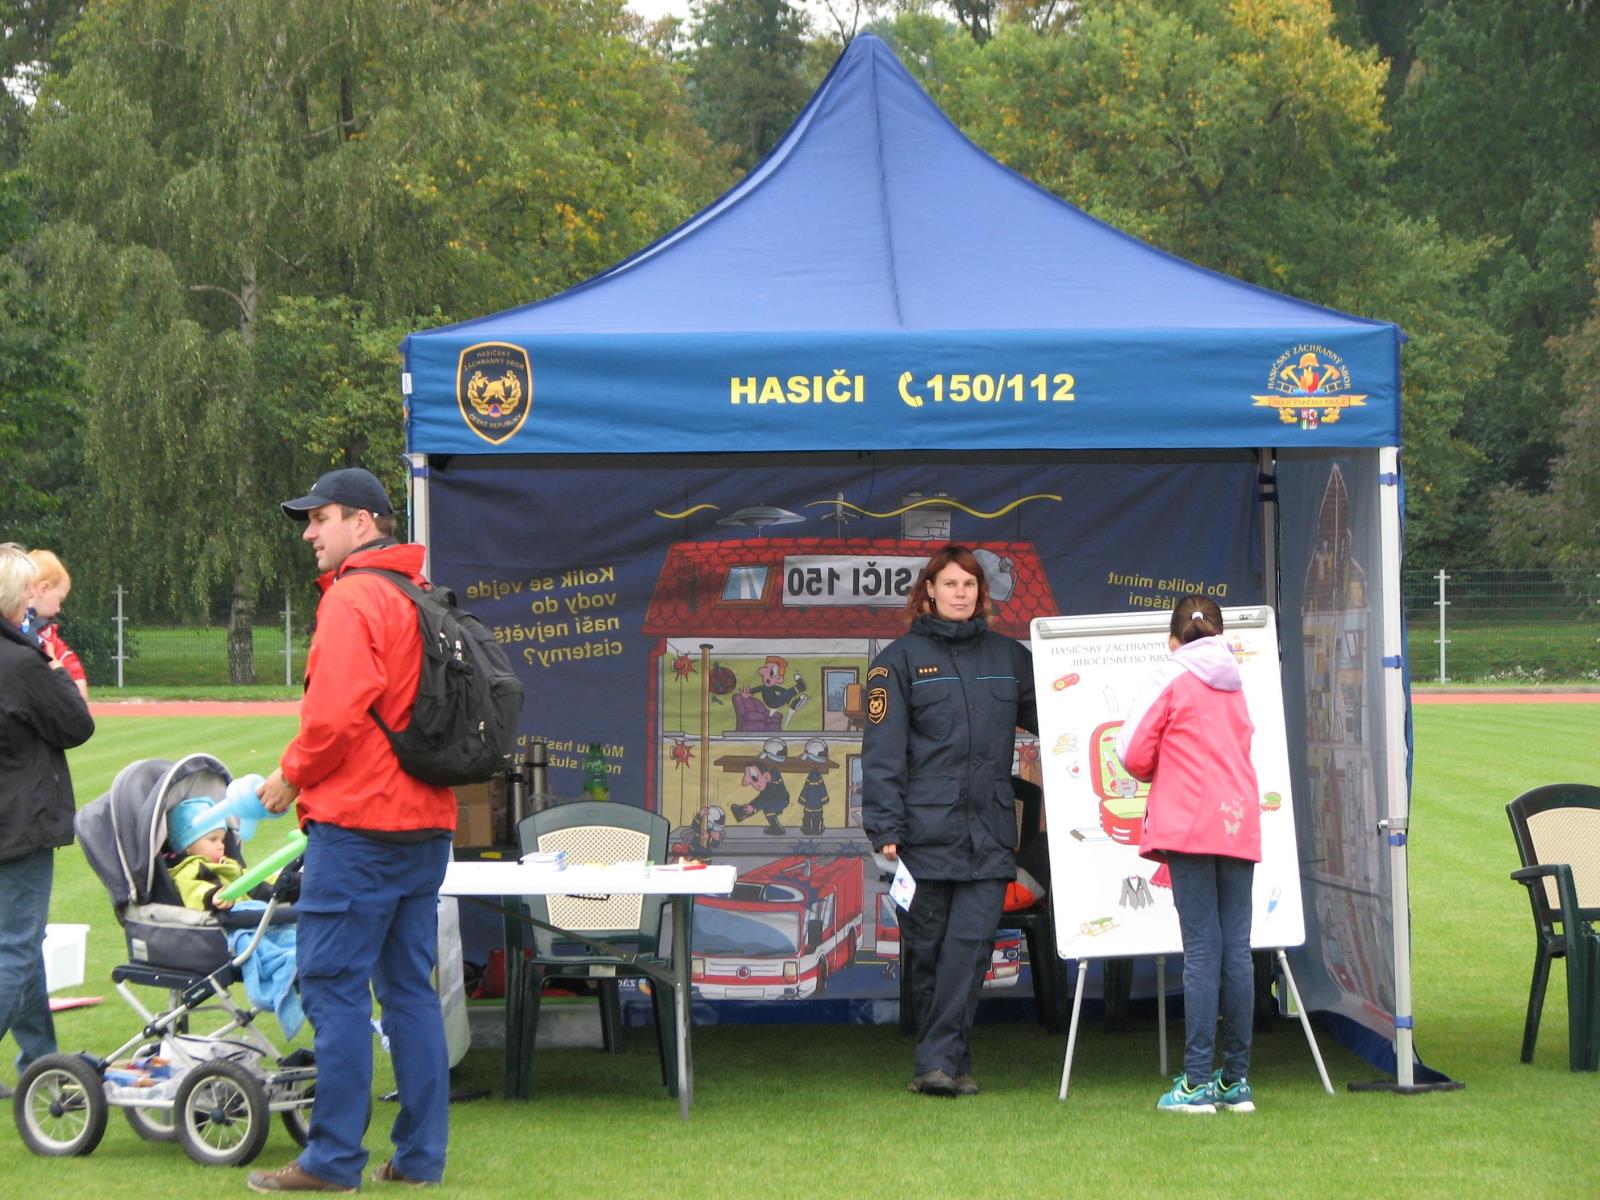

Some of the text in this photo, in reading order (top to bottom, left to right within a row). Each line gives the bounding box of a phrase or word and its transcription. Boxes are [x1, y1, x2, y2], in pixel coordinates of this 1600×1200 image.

[730, 369, 1075, 404] HASIČI 150/112
[1149, 653, 1169, 663] KRA
